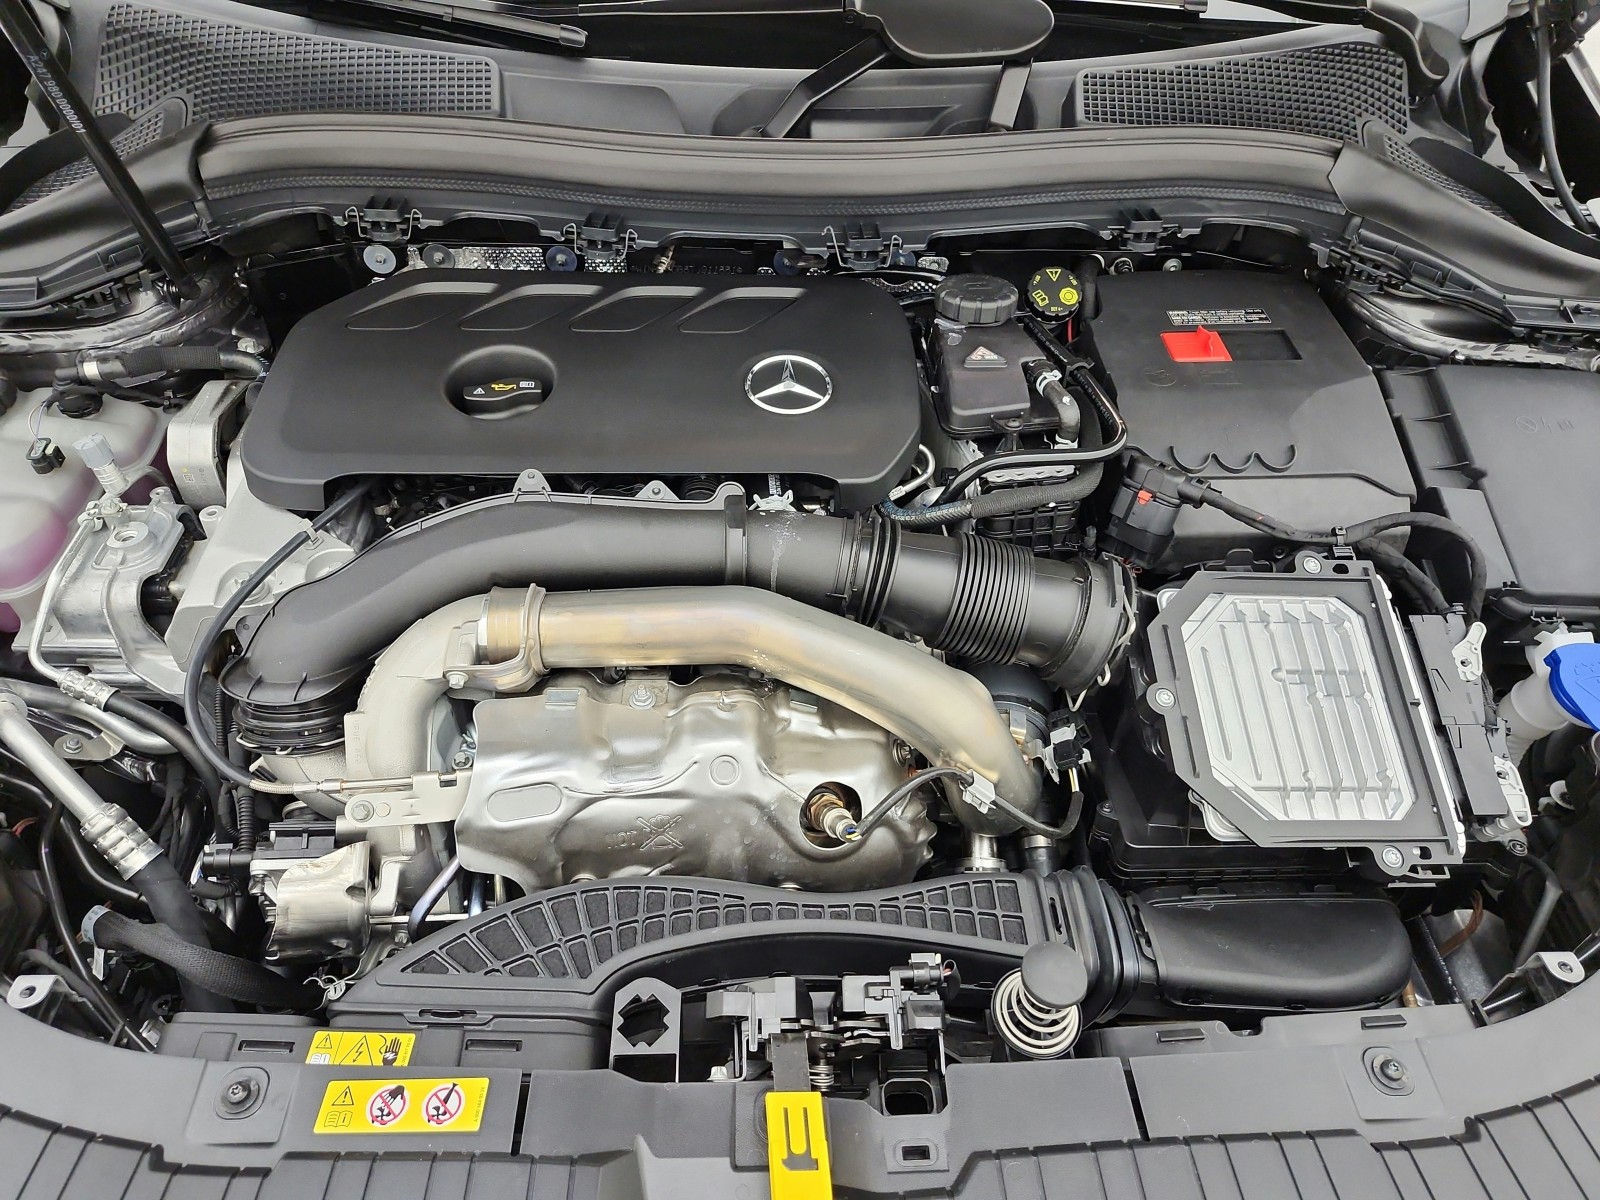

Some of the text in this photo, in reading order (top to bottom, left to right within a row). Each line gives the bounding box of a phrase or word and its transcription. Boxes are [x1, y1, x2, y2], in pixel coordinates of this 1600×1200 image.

[26, 55, 86, 133] A247 980 0000/01
